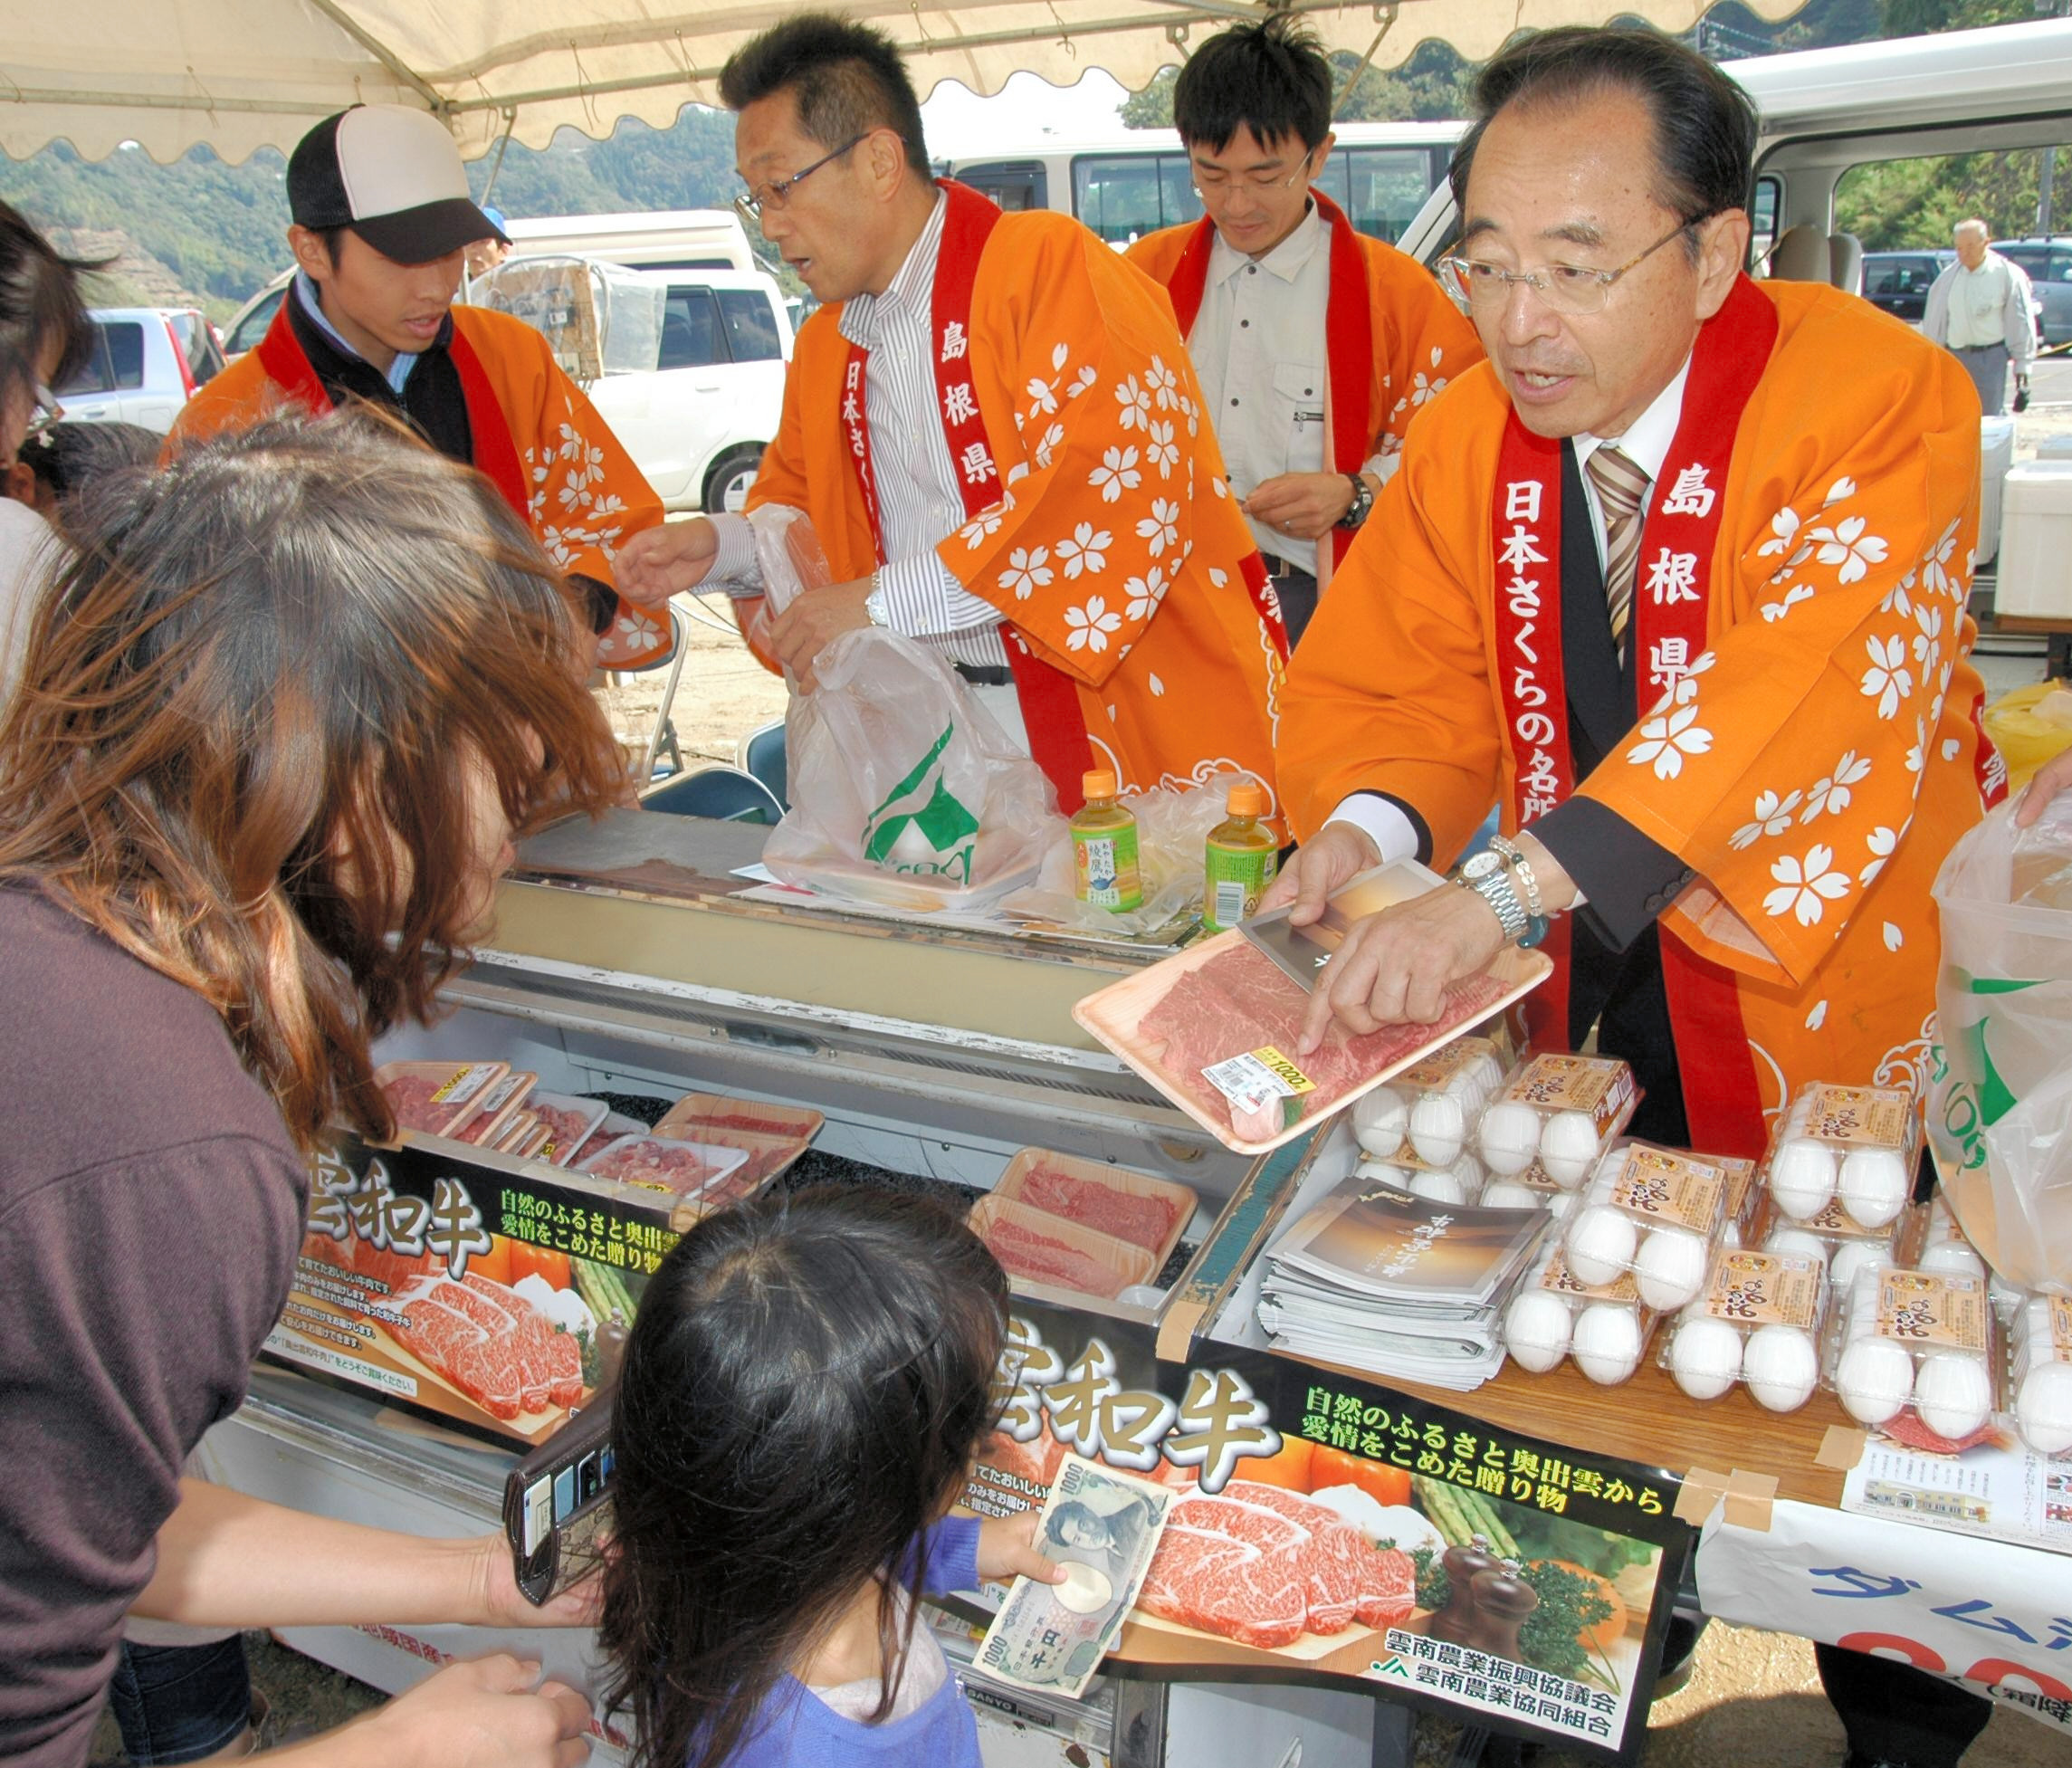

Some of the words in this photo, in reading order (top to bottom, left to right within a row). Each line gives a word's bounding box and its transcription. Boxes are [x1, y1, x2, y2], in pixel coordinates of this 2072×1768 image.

[941, 320, 998, 484] 島根県
[1644, 462, 1717, 690] 島根県
[1059, 1463, 1084, 1495] 1000
[1302, 1414, 1569, 1515] 愛情をこめた贈り物
[1305, 1386, 1664, 1516] 自然のふるさと奥出雲から
[981, 1635, 1008, 1668] 1000
[1030, 1629, 1061, 1669] 千円
[1385, 1629, 1618, 1716] 雲南農業振興協議会
[966, 1688, 1012, 1711] SANYO
[1414, 1662, 1612, 1738] 雲南農業協同組合
